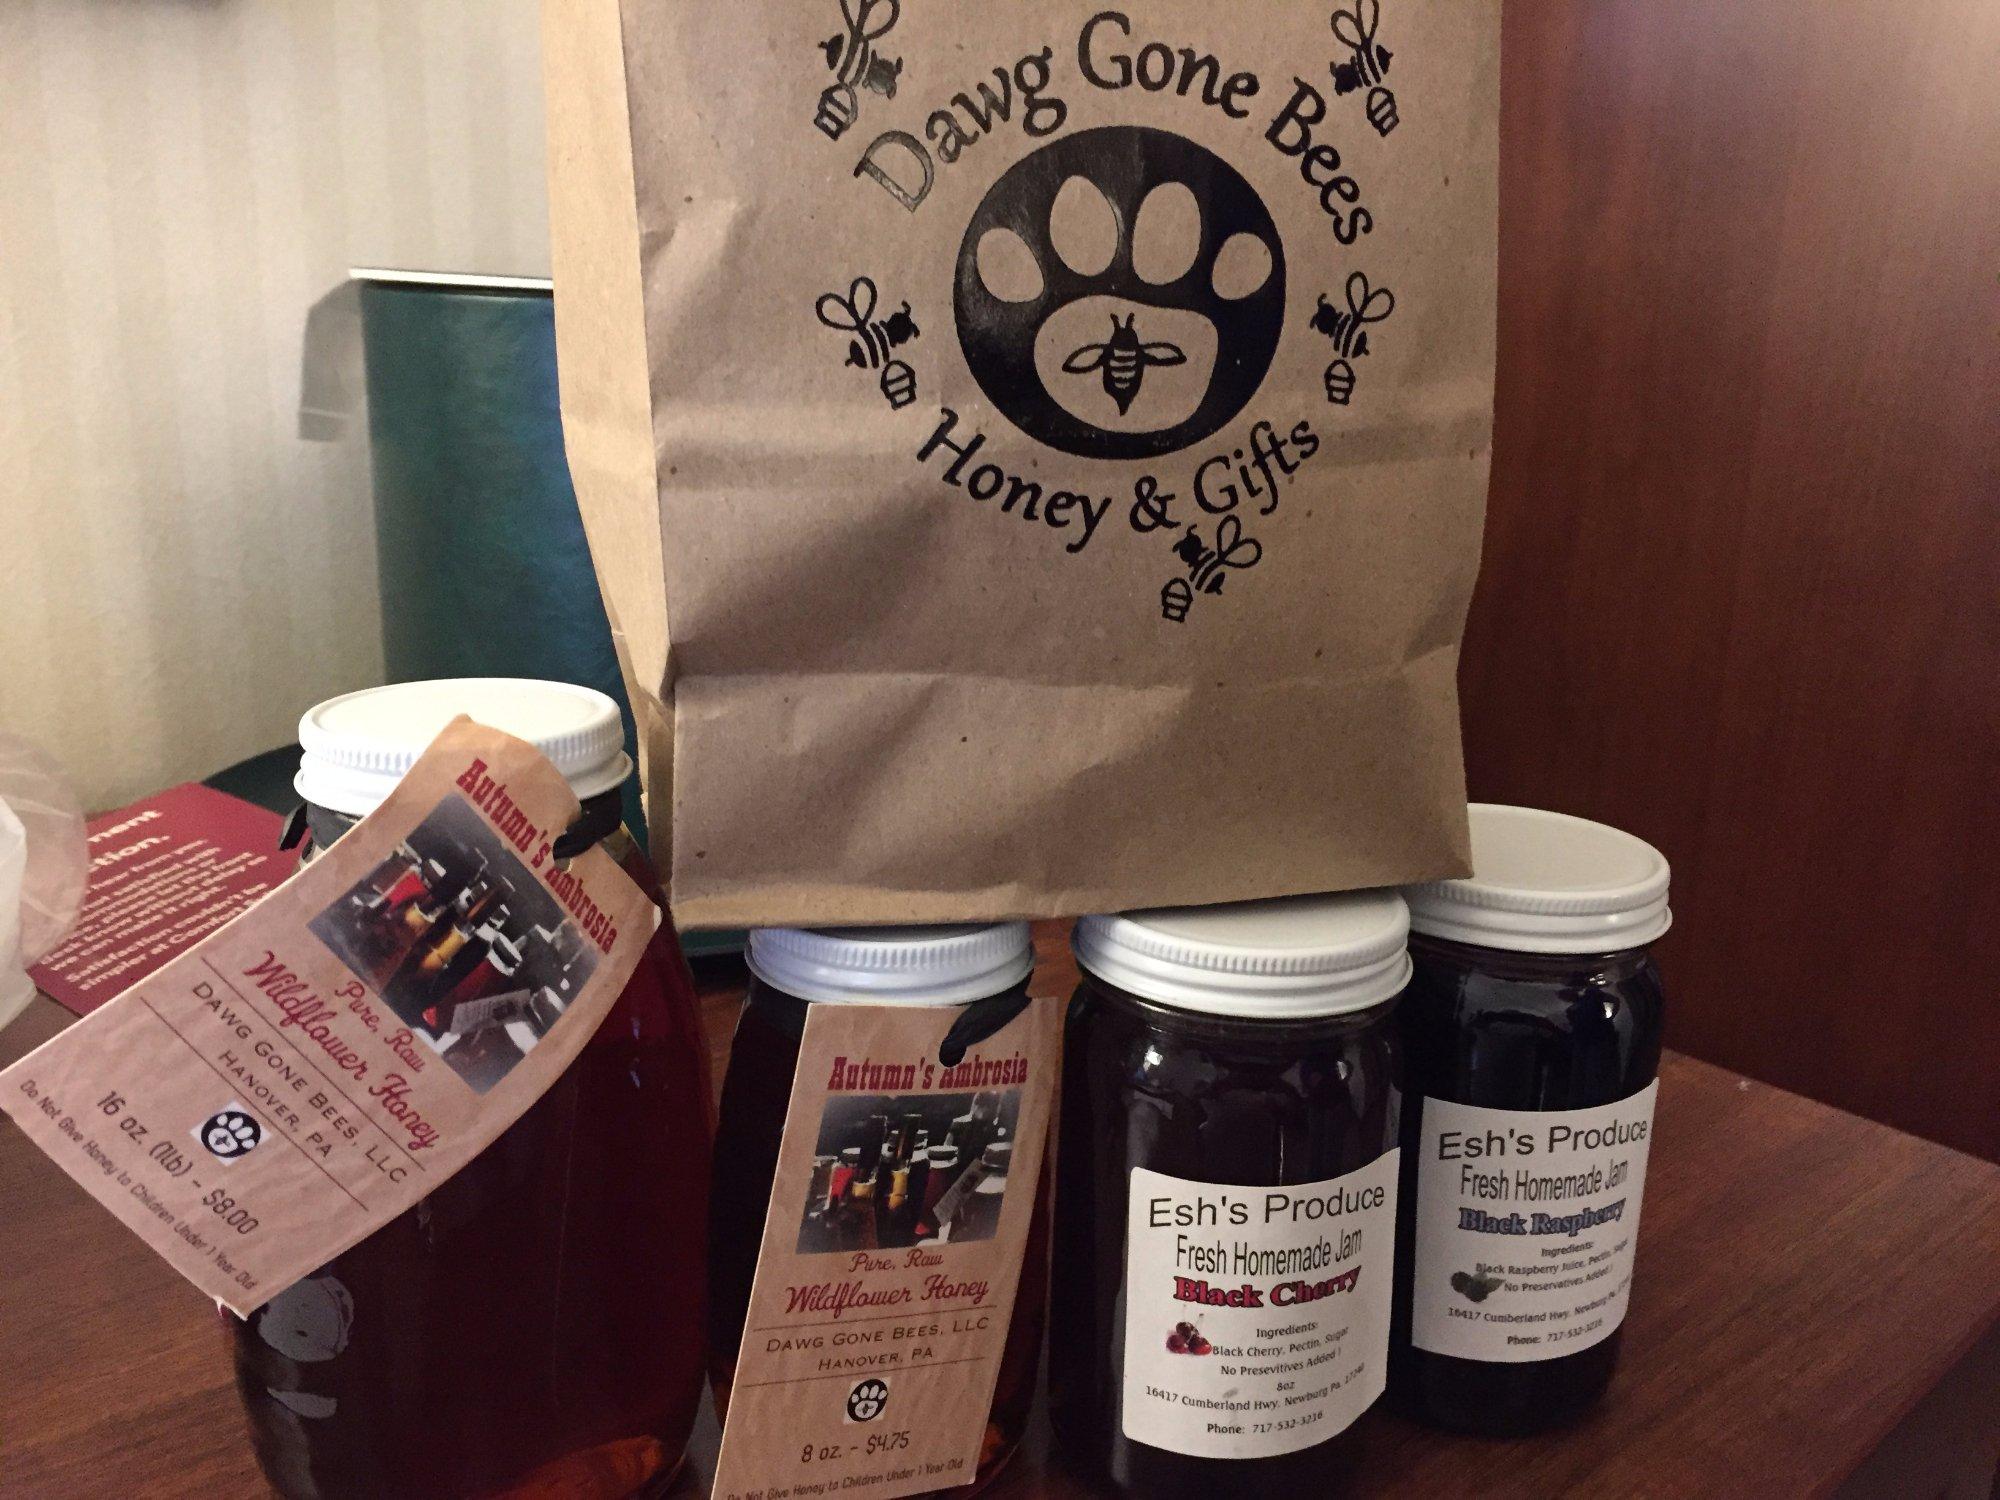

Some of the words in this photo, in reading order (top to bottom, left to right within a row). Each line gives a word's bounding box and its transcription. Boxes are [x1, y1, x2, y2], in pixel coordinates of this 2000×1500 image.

[853, 46, 1067, 213] Dawg
[1077, 11, 1260, 119] Gone
[1265, 77, 1373, 245] Bees
[916, 408, 1112, 553] Honey
[1129, 476, 1180, 532] &
[1194, 420, 1319, 515] Gifts
[456, 758, 553, 869] Autumn's
[335, 981, 380, 1032] Pure,
[384, 1028, 426, 1073] Raw
[243, 950, 368, 1081] Wildflower
[369, 1074, 440, 1150] Honey
[192, 981, 252, 1040] DAWG
[254, 1041, 308, 1092] GONE
[365, 1145, 407, 1184] LLC
[827, 1057, 935, 1091] Autumn's
[218, 1050, 300, 1133] HANOVER,
[306, 1131, 333, 1158] PA
[1439, 1128, 1535, 1161] Esh's
[1548, 1119, 1647, 1153] Produce
[97, 1090, 126, 1116] 16
[202, 1188, 259, 1235] $8.00
[1460, 1164, 1509, 1200] Fresh
[1515, 1164, 1602, 1201] Homemade
[1605, 1158, 1629, 1190] Jam
[20, 1079, 38, 1098] Do
[37, 1096, 61, 1120] Not
[58, 1116, 84, 1143] Give
[82, 1140, 118, 1176] Honey
[117, 1171, 132, 1187] to
[130, 1183, 175, 1225] Children
[174, 1220, 207, 1249] Under
[212, 1250, 236, 1275] Year
[234, 1271, 259, 1290] Old
[1149, 1196, 1248, 1227] Esh's
[1264, 1185, 1384, 1223] Produce
[1458, 1206, 1527, 1235] Black
[1529, 1197, 1627, 1237] Raspberry
[849, 1250, 896, 1272] Pure,
[904, 1248, 944, 1267] Raw
[1176, 1233, 1227, 1274] Fresh
[1233, 1236, 1331, 1276] Homemade
[1335, 1228, 1362, 1262] Jam
[1476, 1263, 1504, 1274] Black
[1508, 1264, 1560, 1276] Raspberry
[785, 1281, 911, 1319] Wildflower
[921, 1274, 990, 1304] Honey
[1173, 1276, 1264, 1308] Black
[1270, 1265, 1362, 1307] Cherry
[1504, 1281, 1518, 1292] No
[766, 1338, 824, 1352] DAWG
[832, 1330, 883, 1346] GONE
[952, 1317, 990, 1333] LLC
[1484, 1312, 1546, 1323] Cumberland
[818, 1353, 903, 1371] HANOVER,
[911, 1347, 933, 1360] PA
[1213, 1345, 1243, 1357] Black
[1324, 1327, 1349, 1343] Sugar
[1221, 1366, 1237, 1376] No
[1306, 1349, 1336, 1367] Added
[1146, 1385, 1178, 1403] 16417
[1181, 1395, 1250, 1411] Cumberland
[1284, 1387, 1328, 1407] Newburg
[1207, 1423, 1245, 1435] Phone:
[1253, 1411, 1324, 1434] 717-532-3216
[801, 1445, 813, 1463] 8
[867, 1431, 910, 1455] $4.75
[767, 1487, 789, 1500] Give
[793, 1483, 825, 1496] Honey
[828, 1481, 839, 1491] to
[842, 1474, 883, 1489] Children
[887, 1470, 914, 1483] Under
[925, 1463, 944, 1475] Year
[948, 1459, 963, 1471] Old
